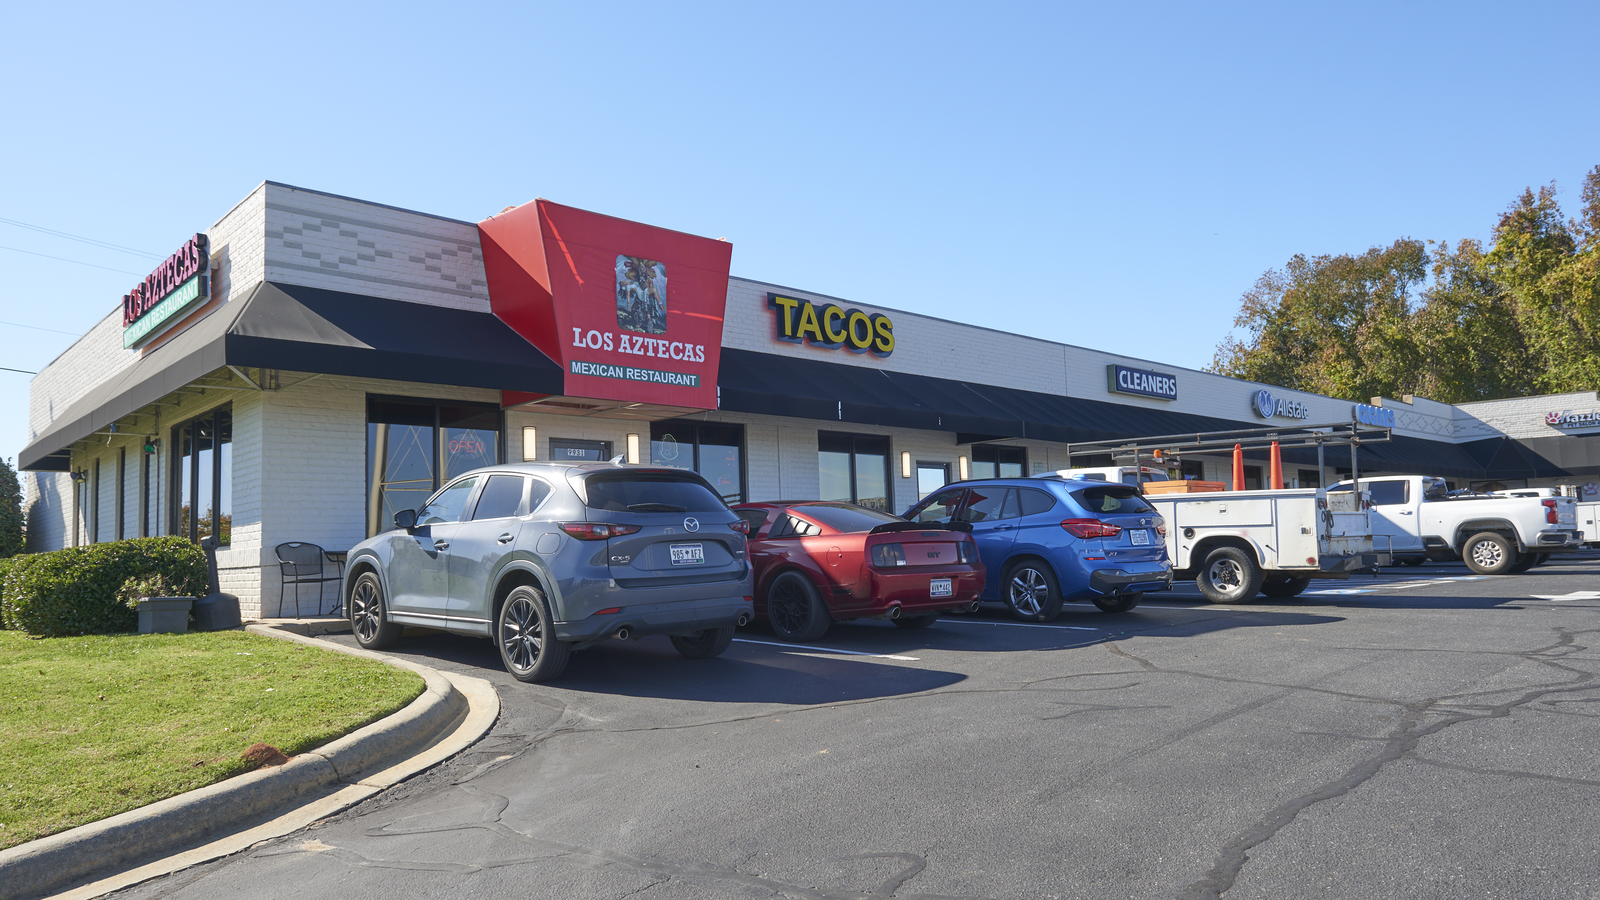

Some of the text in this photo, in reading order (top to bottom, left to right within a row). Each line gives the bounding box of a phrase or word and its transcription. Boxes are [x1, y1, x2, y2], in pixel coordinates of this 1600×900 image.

[122, 233, 199, 327] LOS AZTECAS
[124, 278, 198, 347] MEXICAN RESTAURANT
[775, 296, 895, 352] TACOS
[572, 327, 705, 363] LOS AZTECAS
[571, 361, 697, 386] MEXICAN RESTAURANT
[1119, 370, 1176, 396] CLEANERS
[1276, 399, 1309, 419] Allstate
[1356, 403, 1395, 428] CIGARS
[449, 440, 484, 453] OPEN
[568, 448, 585, 457] 9931
[672, 549, 702, 559] 985 AFZ
[942, 583, 950, 591] 442
